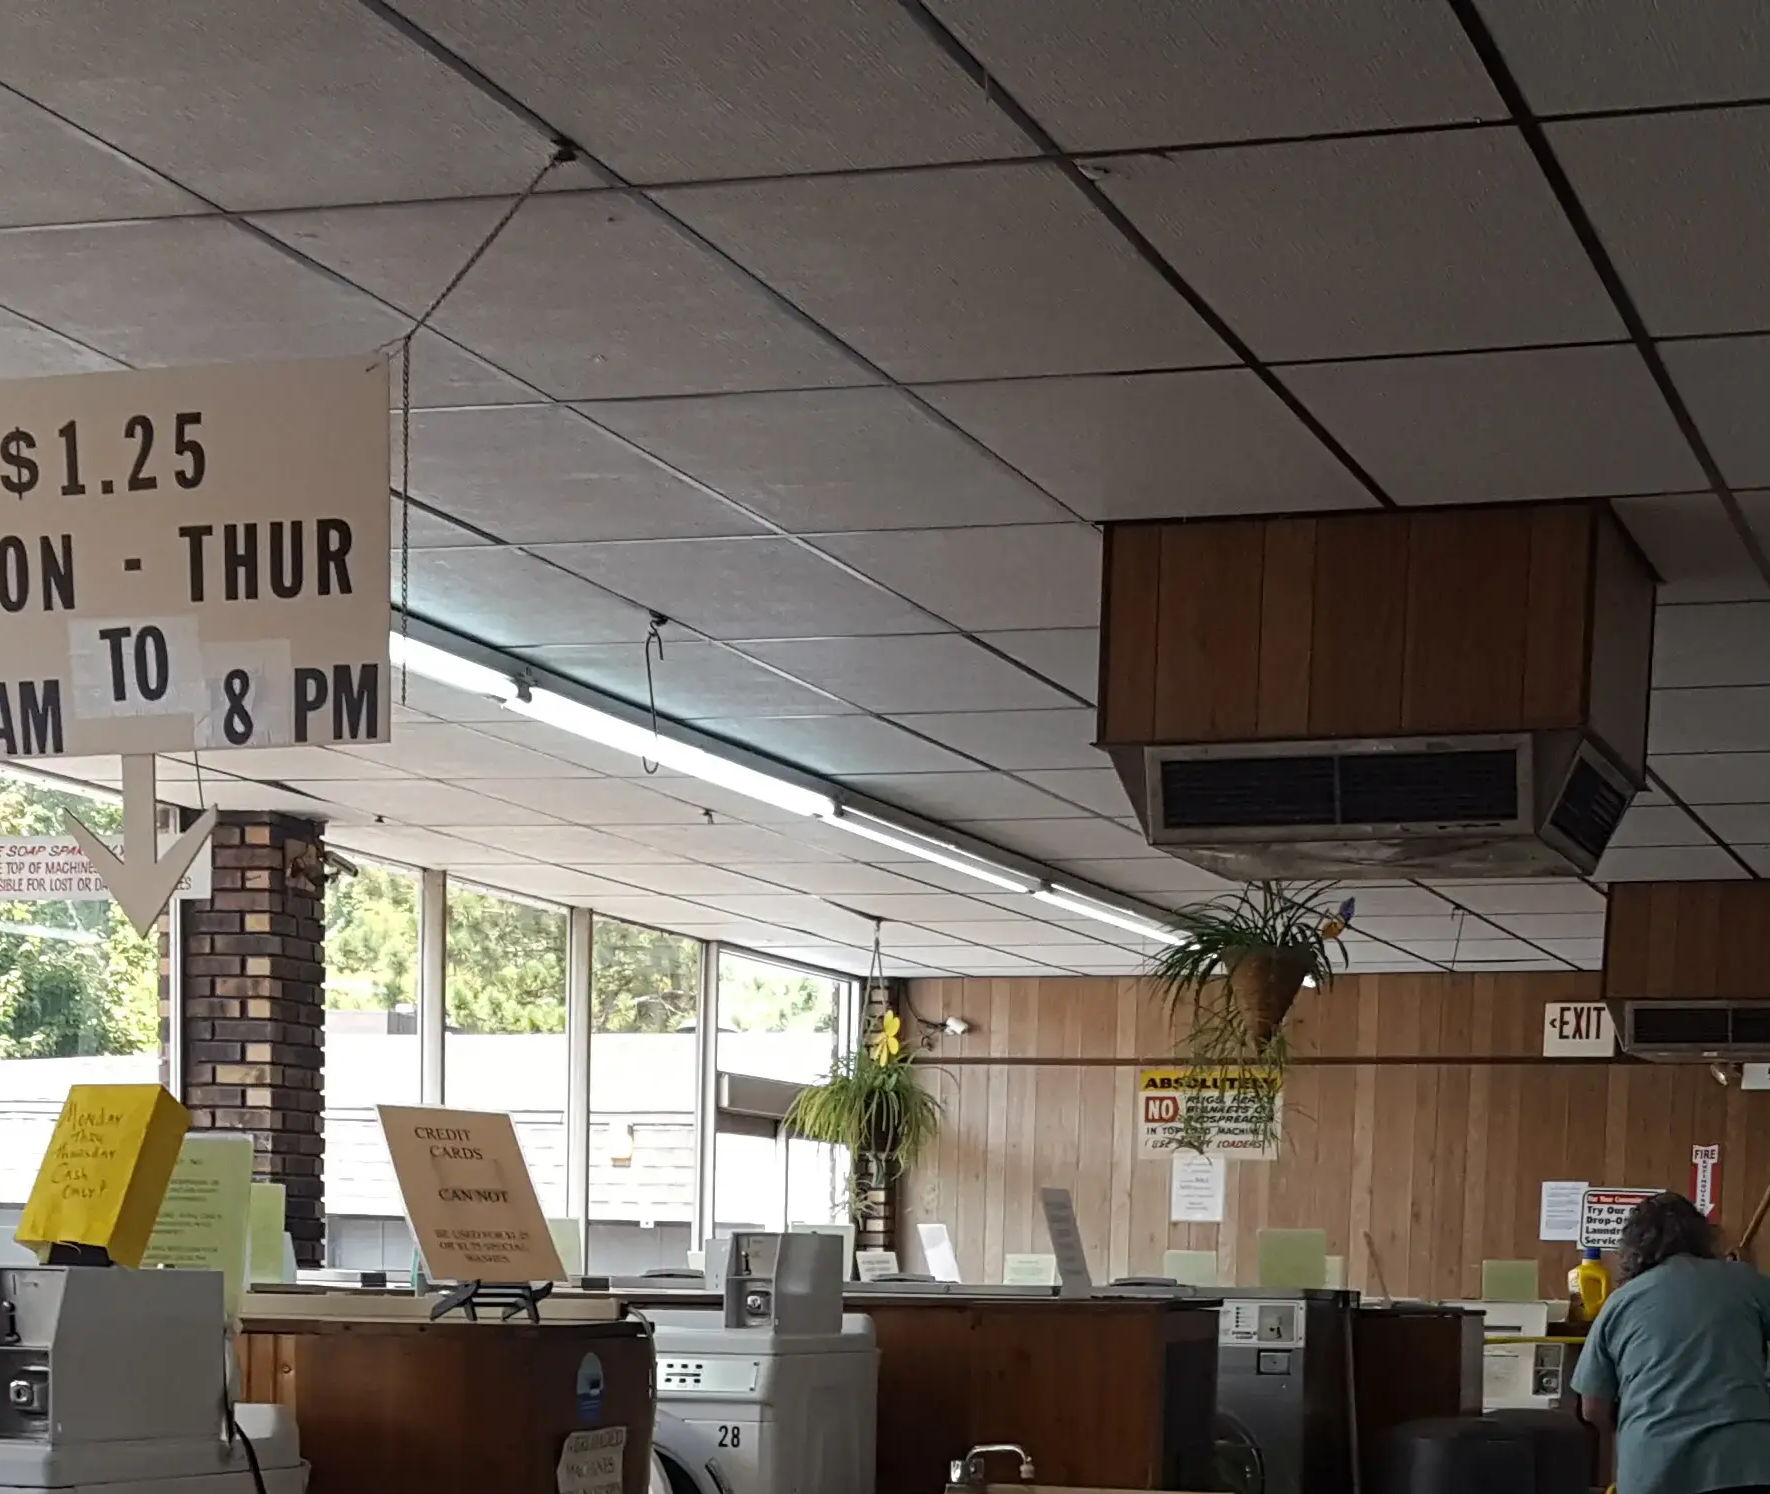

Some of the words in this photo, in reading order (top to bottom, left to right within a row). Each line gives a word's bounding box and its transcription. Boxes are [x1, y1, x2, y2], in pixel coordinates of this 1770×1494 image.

[0, 412, 206, 499] $1.25
[178, 518, 354, 602] THUR
[99, 626, 169, 702] TO
[223, 668, 254, 745] 8
[294, 663, 379, 742] PM
[6, 845, 46, 858] SOAP
[6, 862, 25, 875] TOP
[29, 862, 43, 875] OF
[45, 862, 100, 875] MACHINE
[26, 879, 46, 892] FOR
[49, 879, 74, 892] LOST
[77, 879, 92, 892] OR
[1558, 1006, 1606, 1039] EXIT
[1148, 1098, 1175, 1121] NO
[414, 1126, 471, 1142] CREDIT
[1146, 1127, 1157, 1135] IN
[429, 1145, 484, 1161] CARDS
[1694, 1149, 1716, 1160] FIRE
[438, 1188, 473, 1202] CAN
[474, 1190, 509, 1204] NOT
[1587, 1205, 1604, 1216] Try
[1607, 1206, 1626, 1215] Our
[1585, 1226, 1623, 1235] Laundr
[1585, 1236, 1622, 1245] Servic
[717, 1424, 741, 1448] 28
